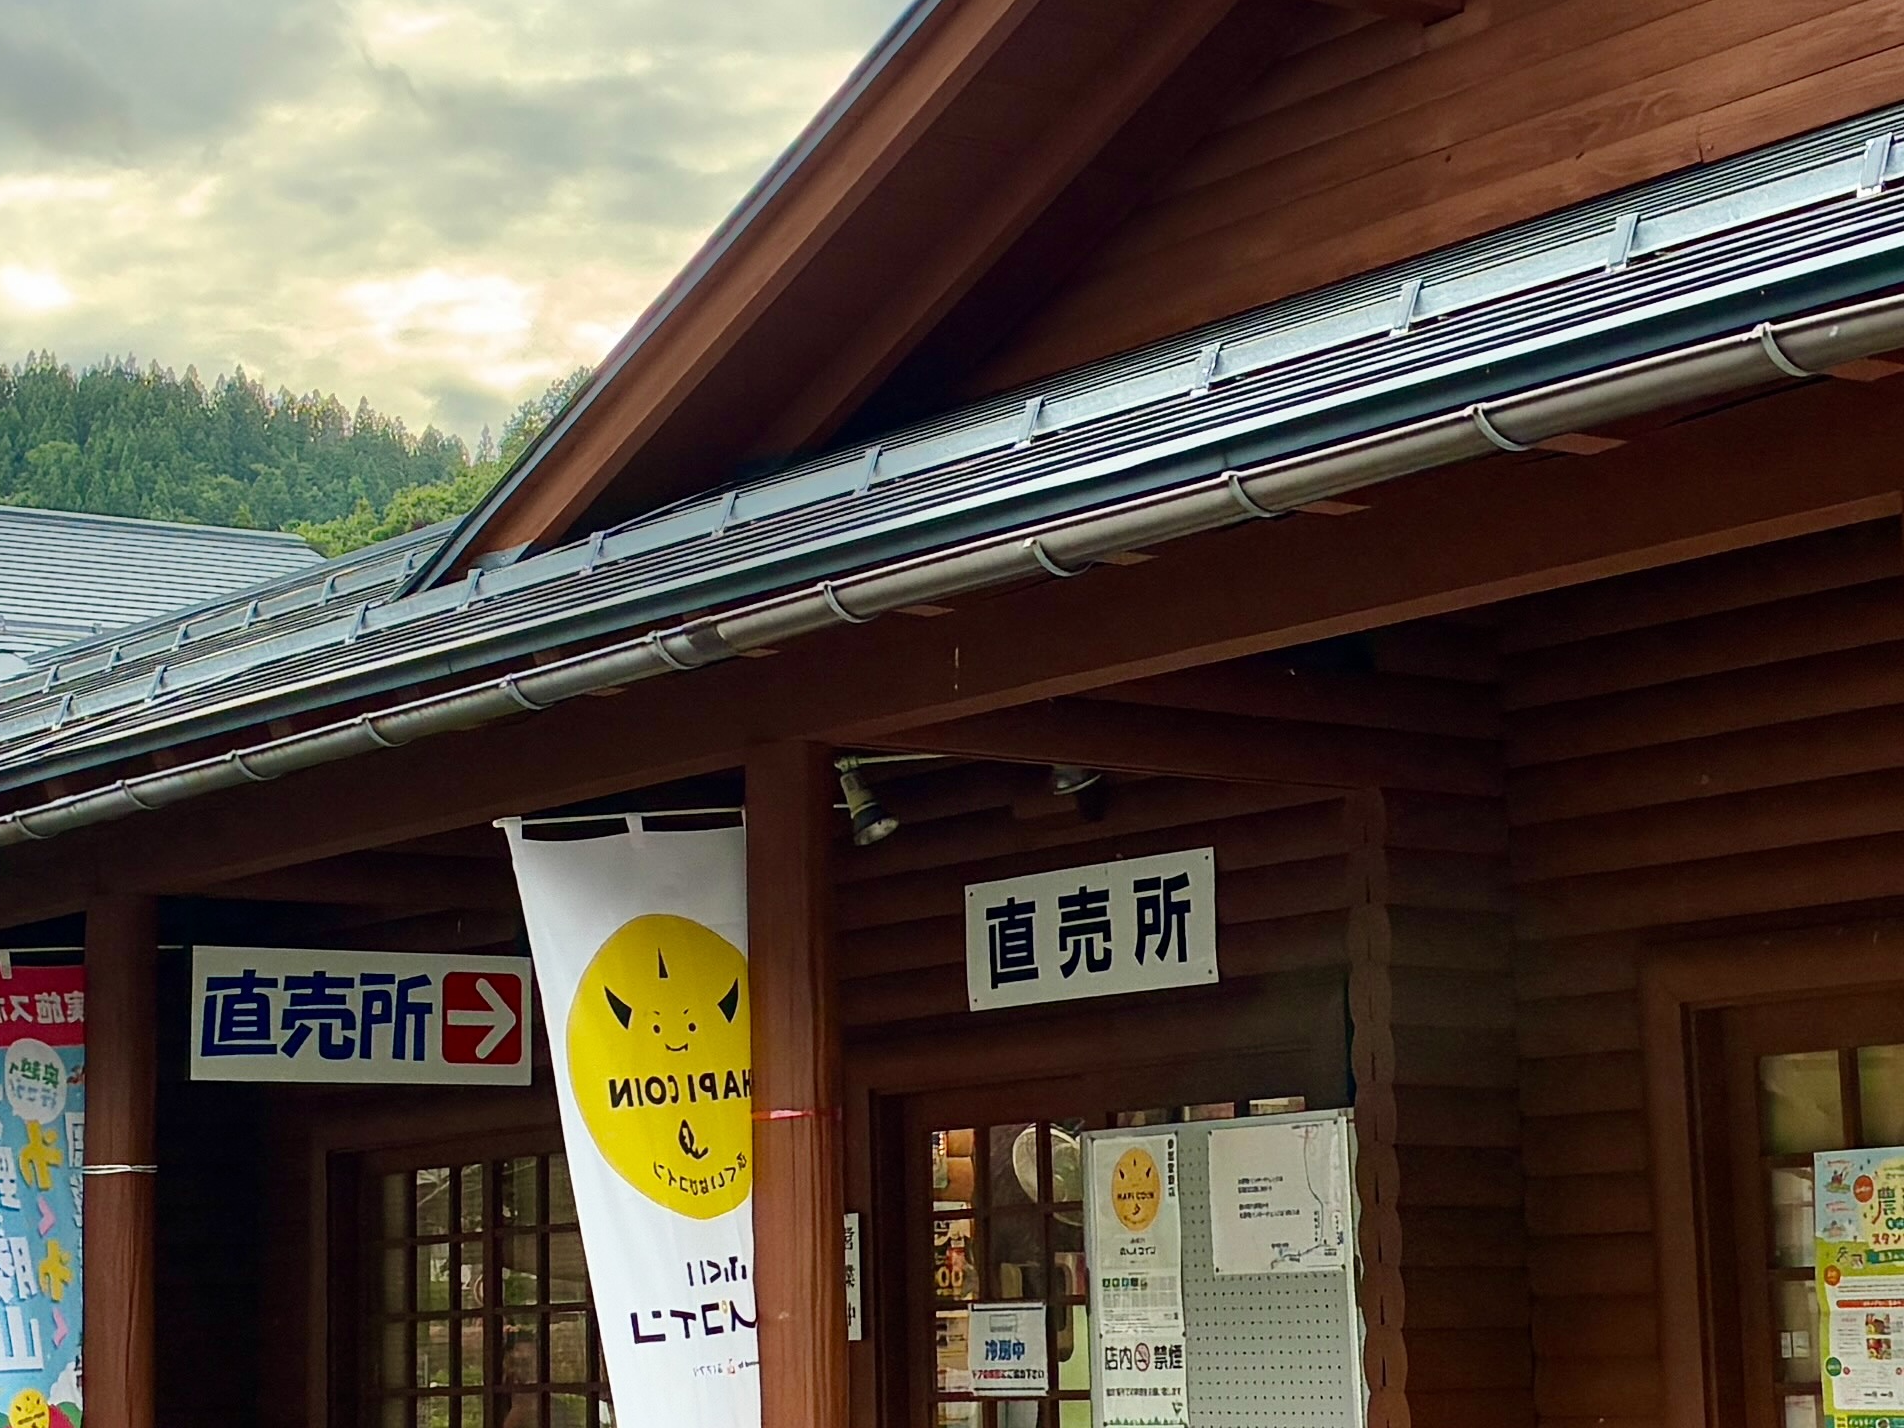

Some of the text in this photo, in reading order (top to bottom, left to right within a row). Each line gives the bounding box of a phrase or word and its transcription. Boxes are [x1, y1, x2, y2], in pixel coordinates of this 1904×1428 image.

[985, 871, 1191, 990] 直売所
[200, 968, 433, 1062] 直売所
[1104, 1344, 1184, 1371] 店内 禁煙
